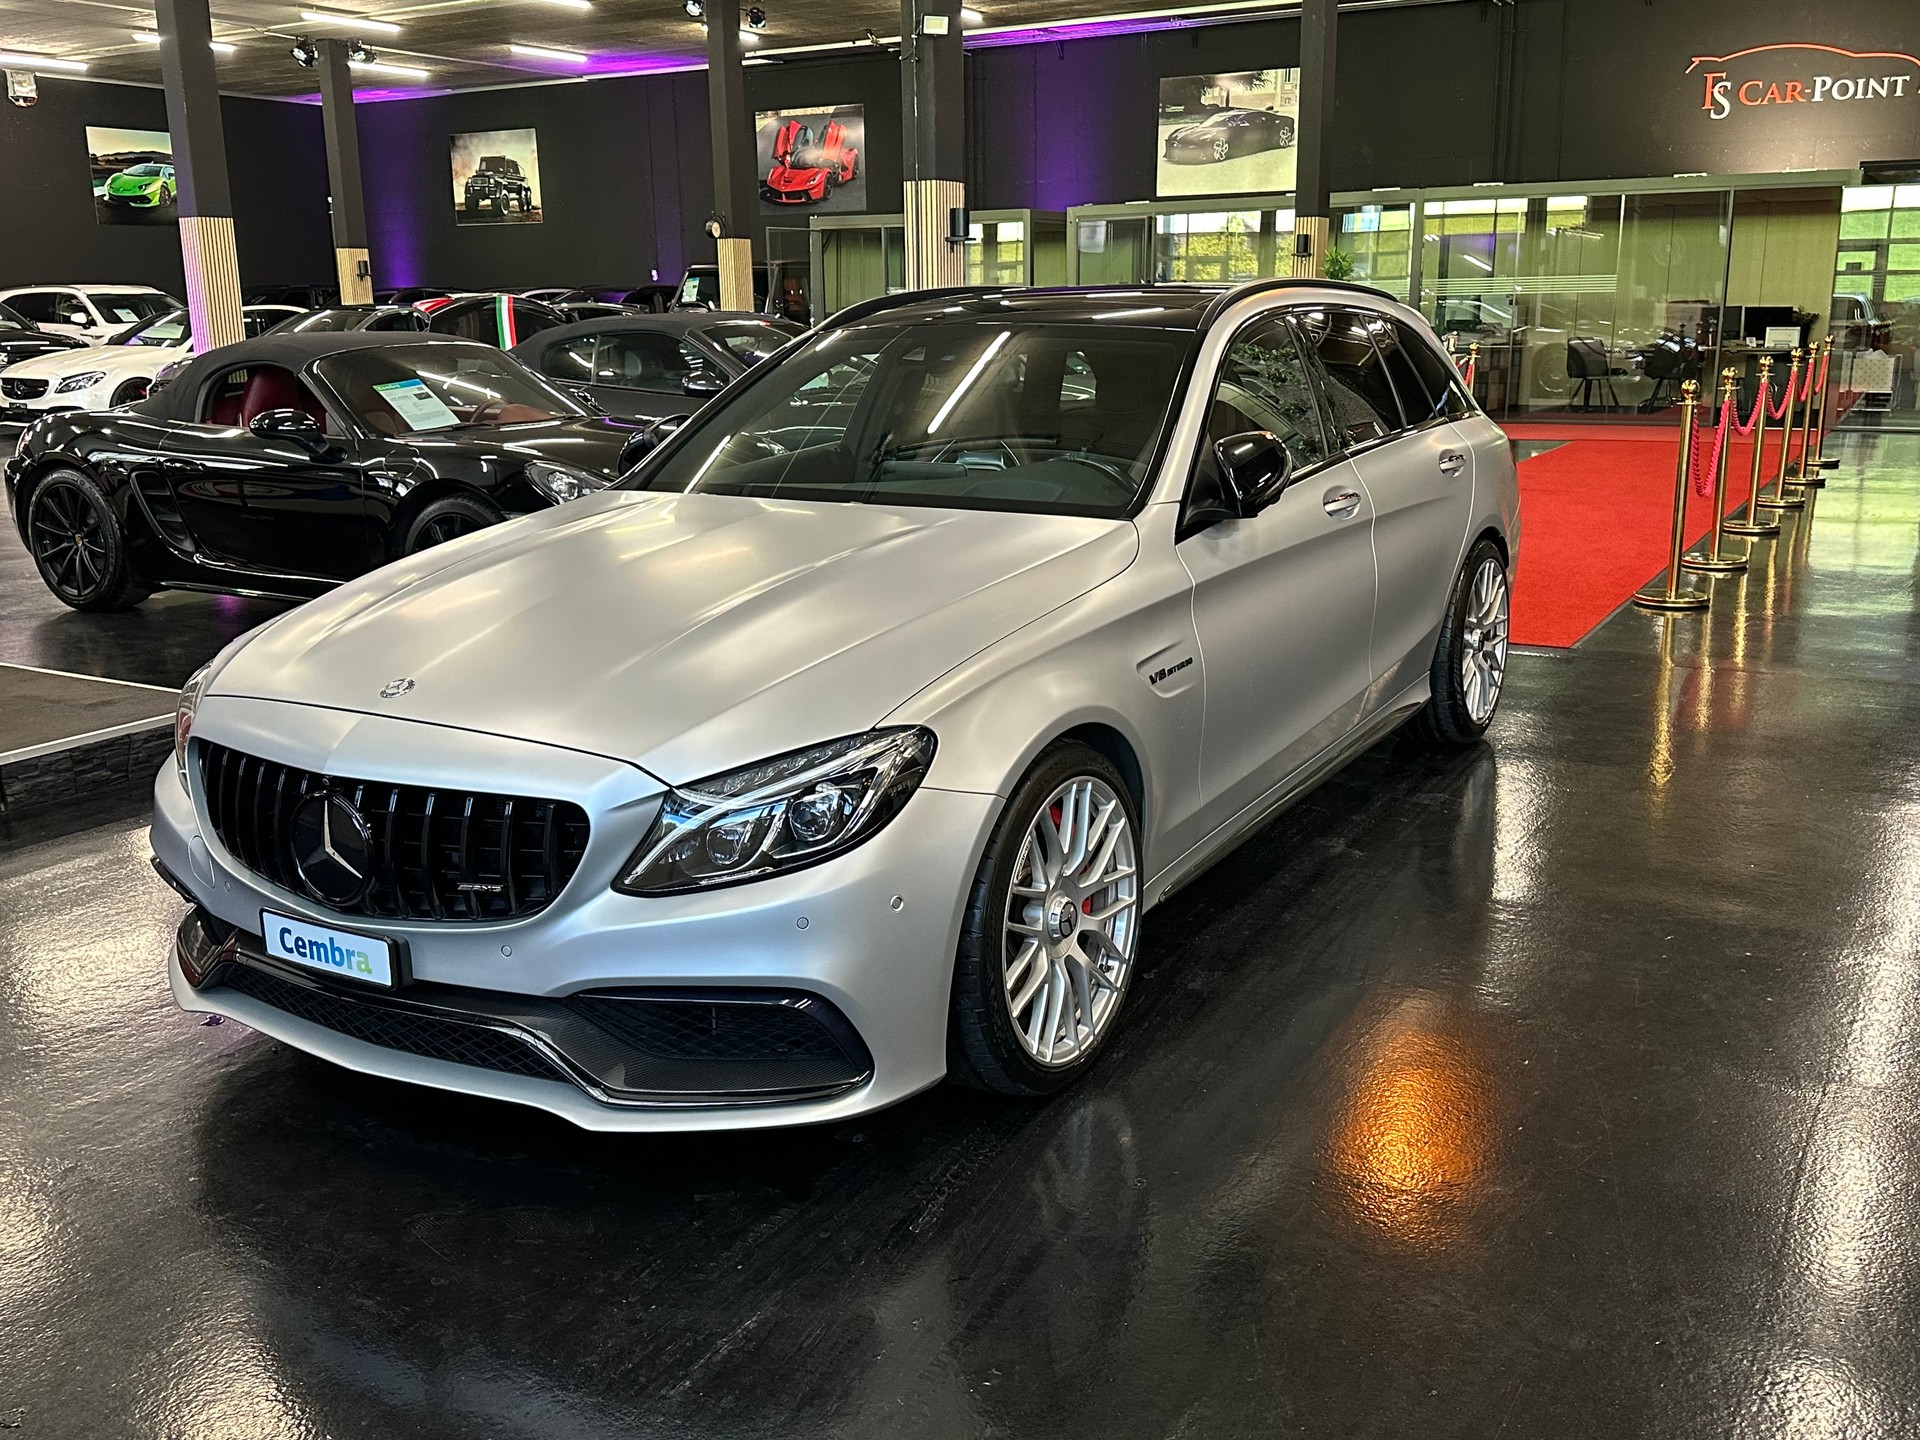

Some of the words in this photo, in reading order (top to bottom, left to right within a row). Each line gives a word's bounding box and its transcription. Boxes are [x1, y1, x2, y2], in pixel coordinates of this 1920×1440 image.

[1738, 75, 1911, 106] CAR-POINT
[1149, 668, 1166, 685] V8
[279, 927, 373, 975] Cembra
